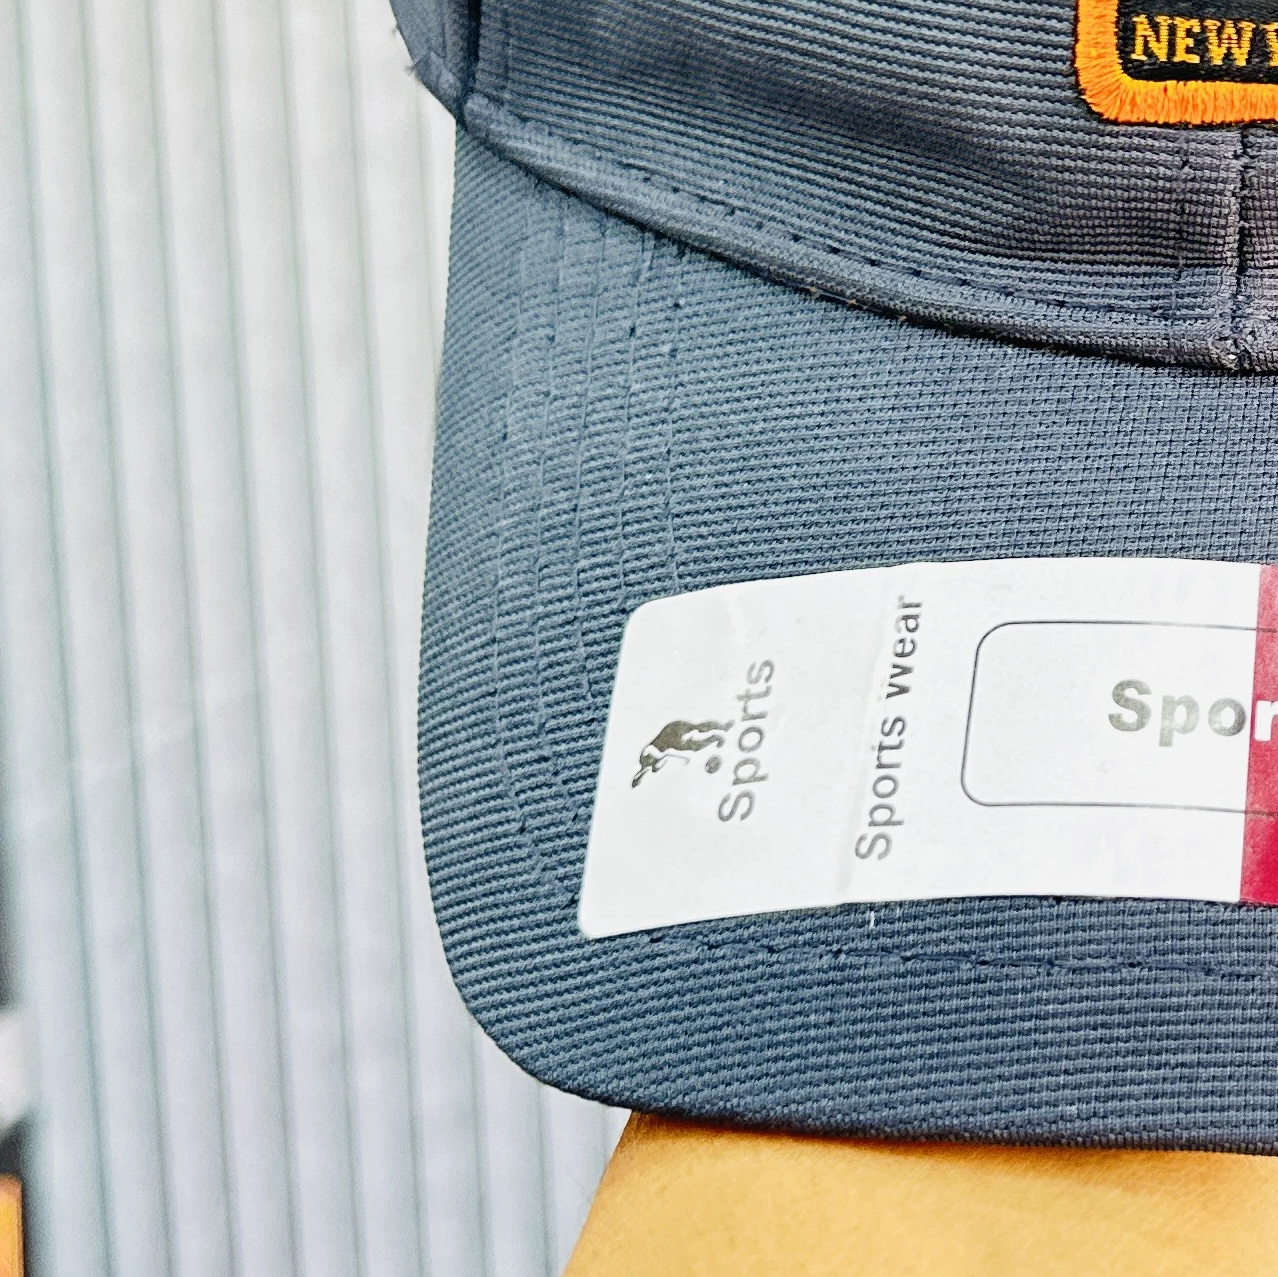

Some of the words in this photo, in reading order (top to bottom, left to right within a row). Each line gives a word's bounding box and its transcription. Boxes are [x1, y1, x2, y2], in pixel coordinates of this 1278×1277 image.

[1131, 14, 1254, 66] NEW
[717, 658, 776, 823] Sports
[854, 715, 906, 861] Sports
[885, 594, 924, 700] wear
